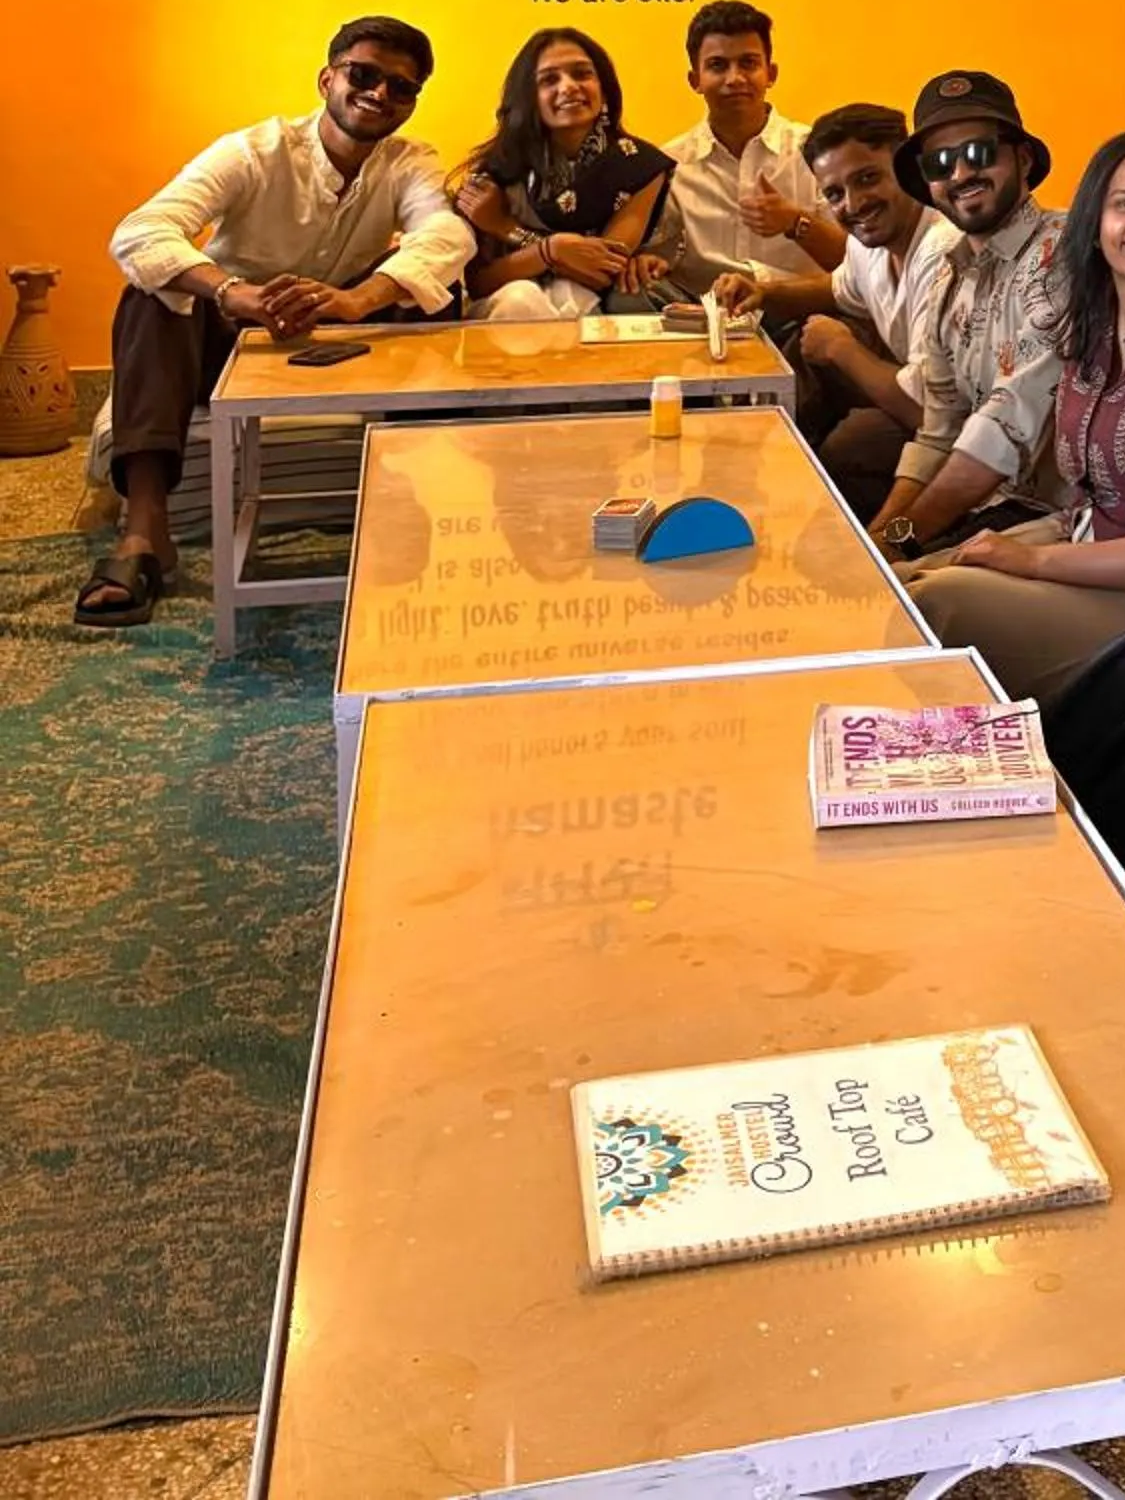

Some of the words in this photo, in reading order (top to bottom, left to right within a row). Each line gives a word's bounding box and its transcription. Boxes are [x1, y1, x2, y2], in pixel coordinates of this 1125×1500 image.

[842, 715, 880, 772] ENDS
[826, 803, 840, 818] IT
[843, 801, 880, 817] ENDS
[882, 798, 917, 816] WITH
[920, 798, 939, 814] US
[828, 1078, 869, 1121] Top
[885, 1093, 934, 1145] Café
[716, 1112, 750, 1188] JAISALMER
[745, 1108, 772, 1160] HOSTEL
[831, 1124, 888, 1182] Roof
